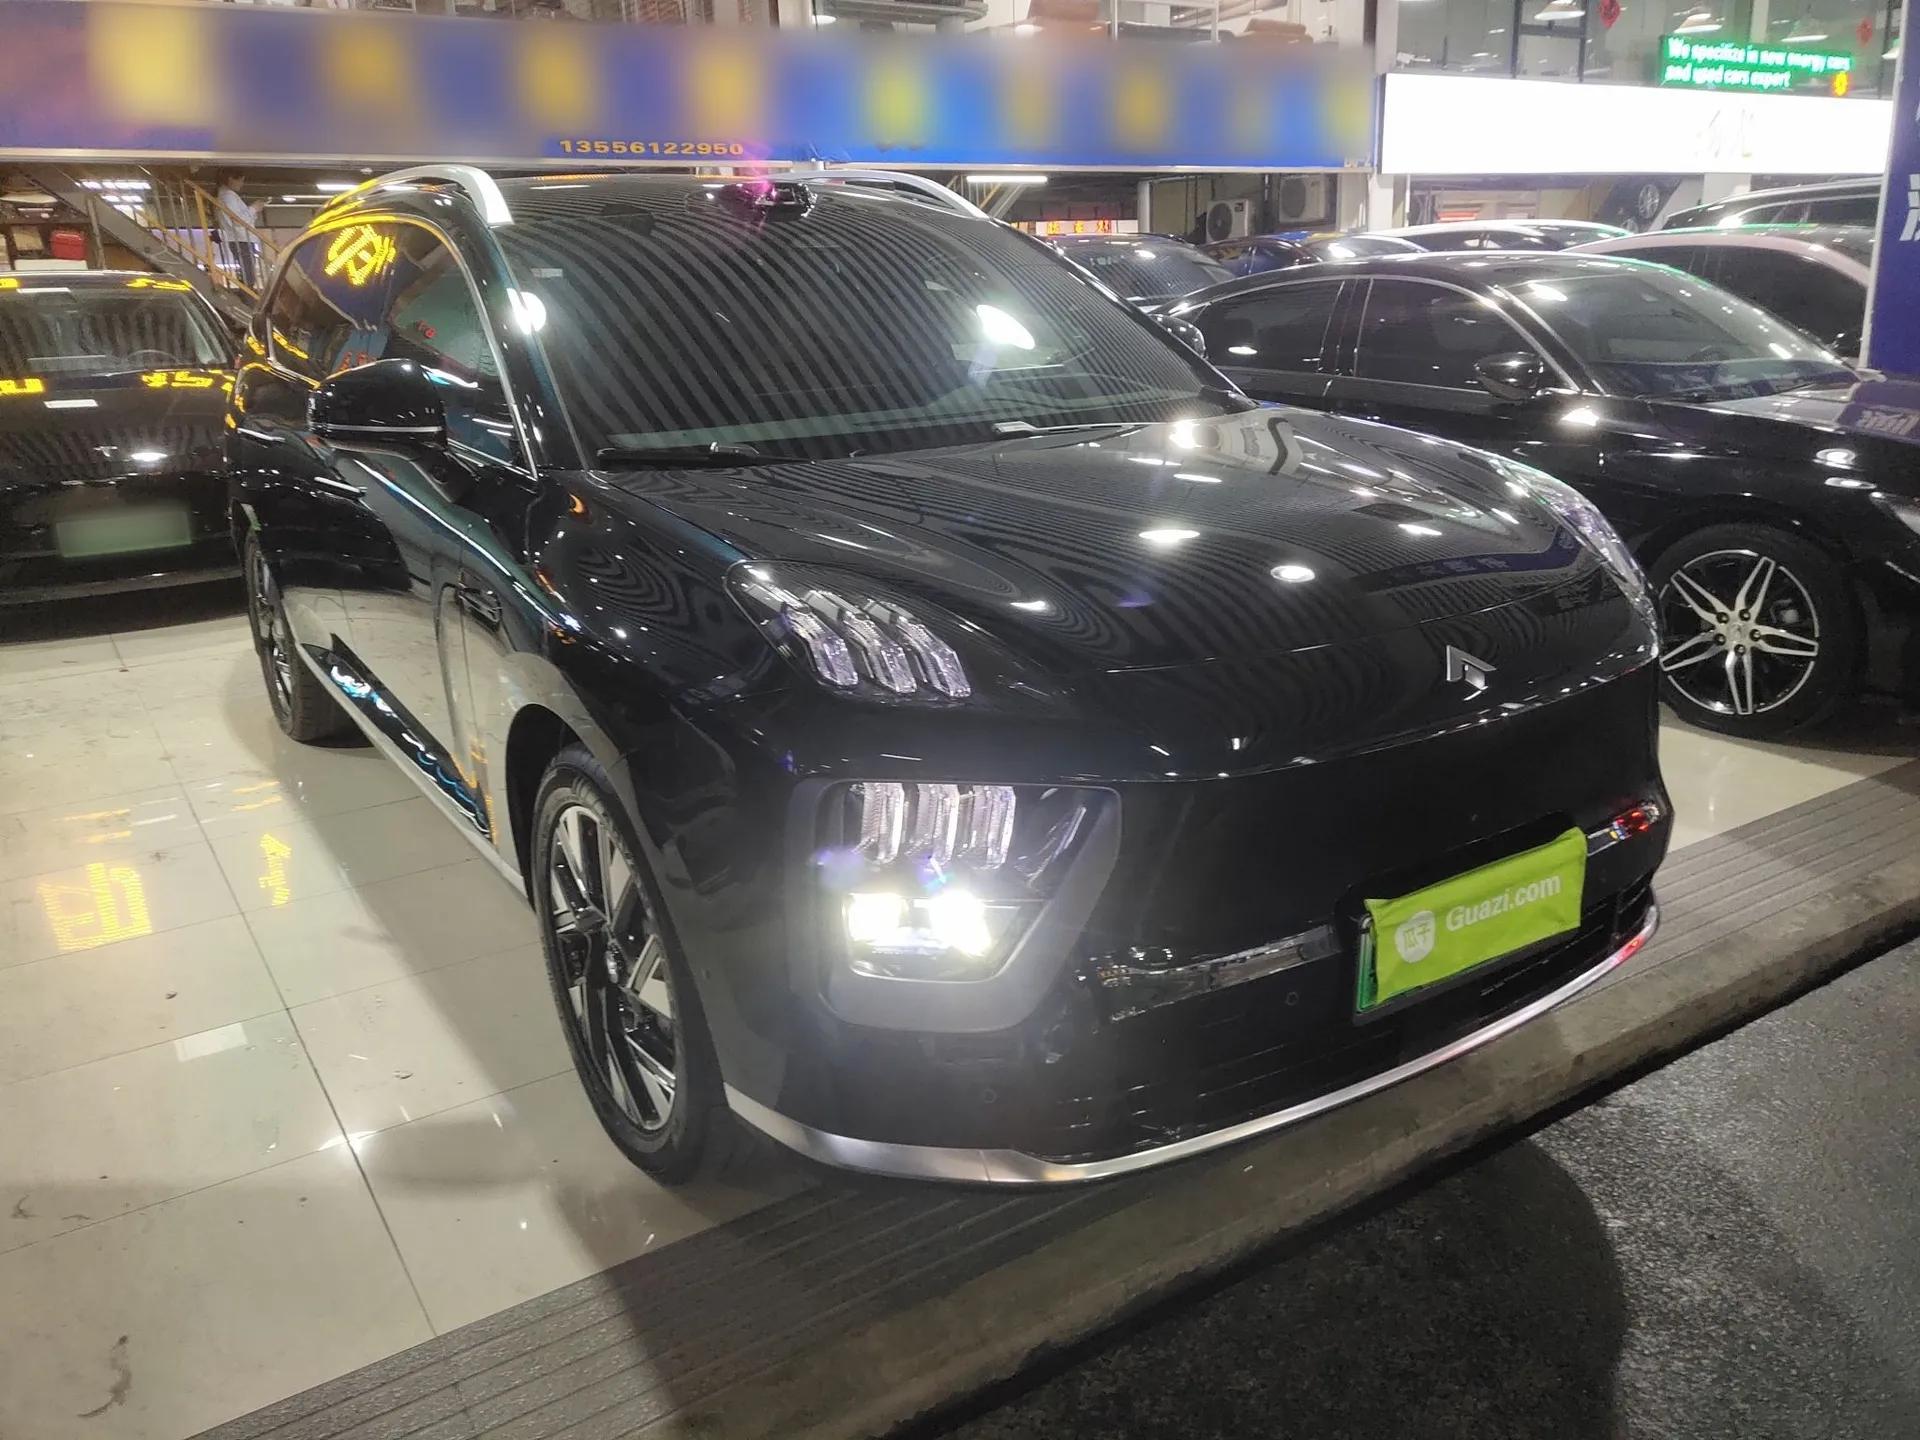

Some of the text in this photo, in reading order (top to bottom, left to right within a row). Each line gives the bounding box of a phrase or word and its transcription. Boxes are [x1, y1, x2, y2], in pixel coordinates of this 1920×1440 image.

[1668, 37, 1691, 60] We
[1746, 44, 1759, 65] in
[1760, 50, 1787, 66] new
[1787, 52, 1827, 73] energy
[1826, 55, 1850, 71] cars
[1665, 62, 1791, 89] and used cars export
[559, 140, 744, 155] 13556122950
[1446, 875, 1562, 932] Guazi.com
